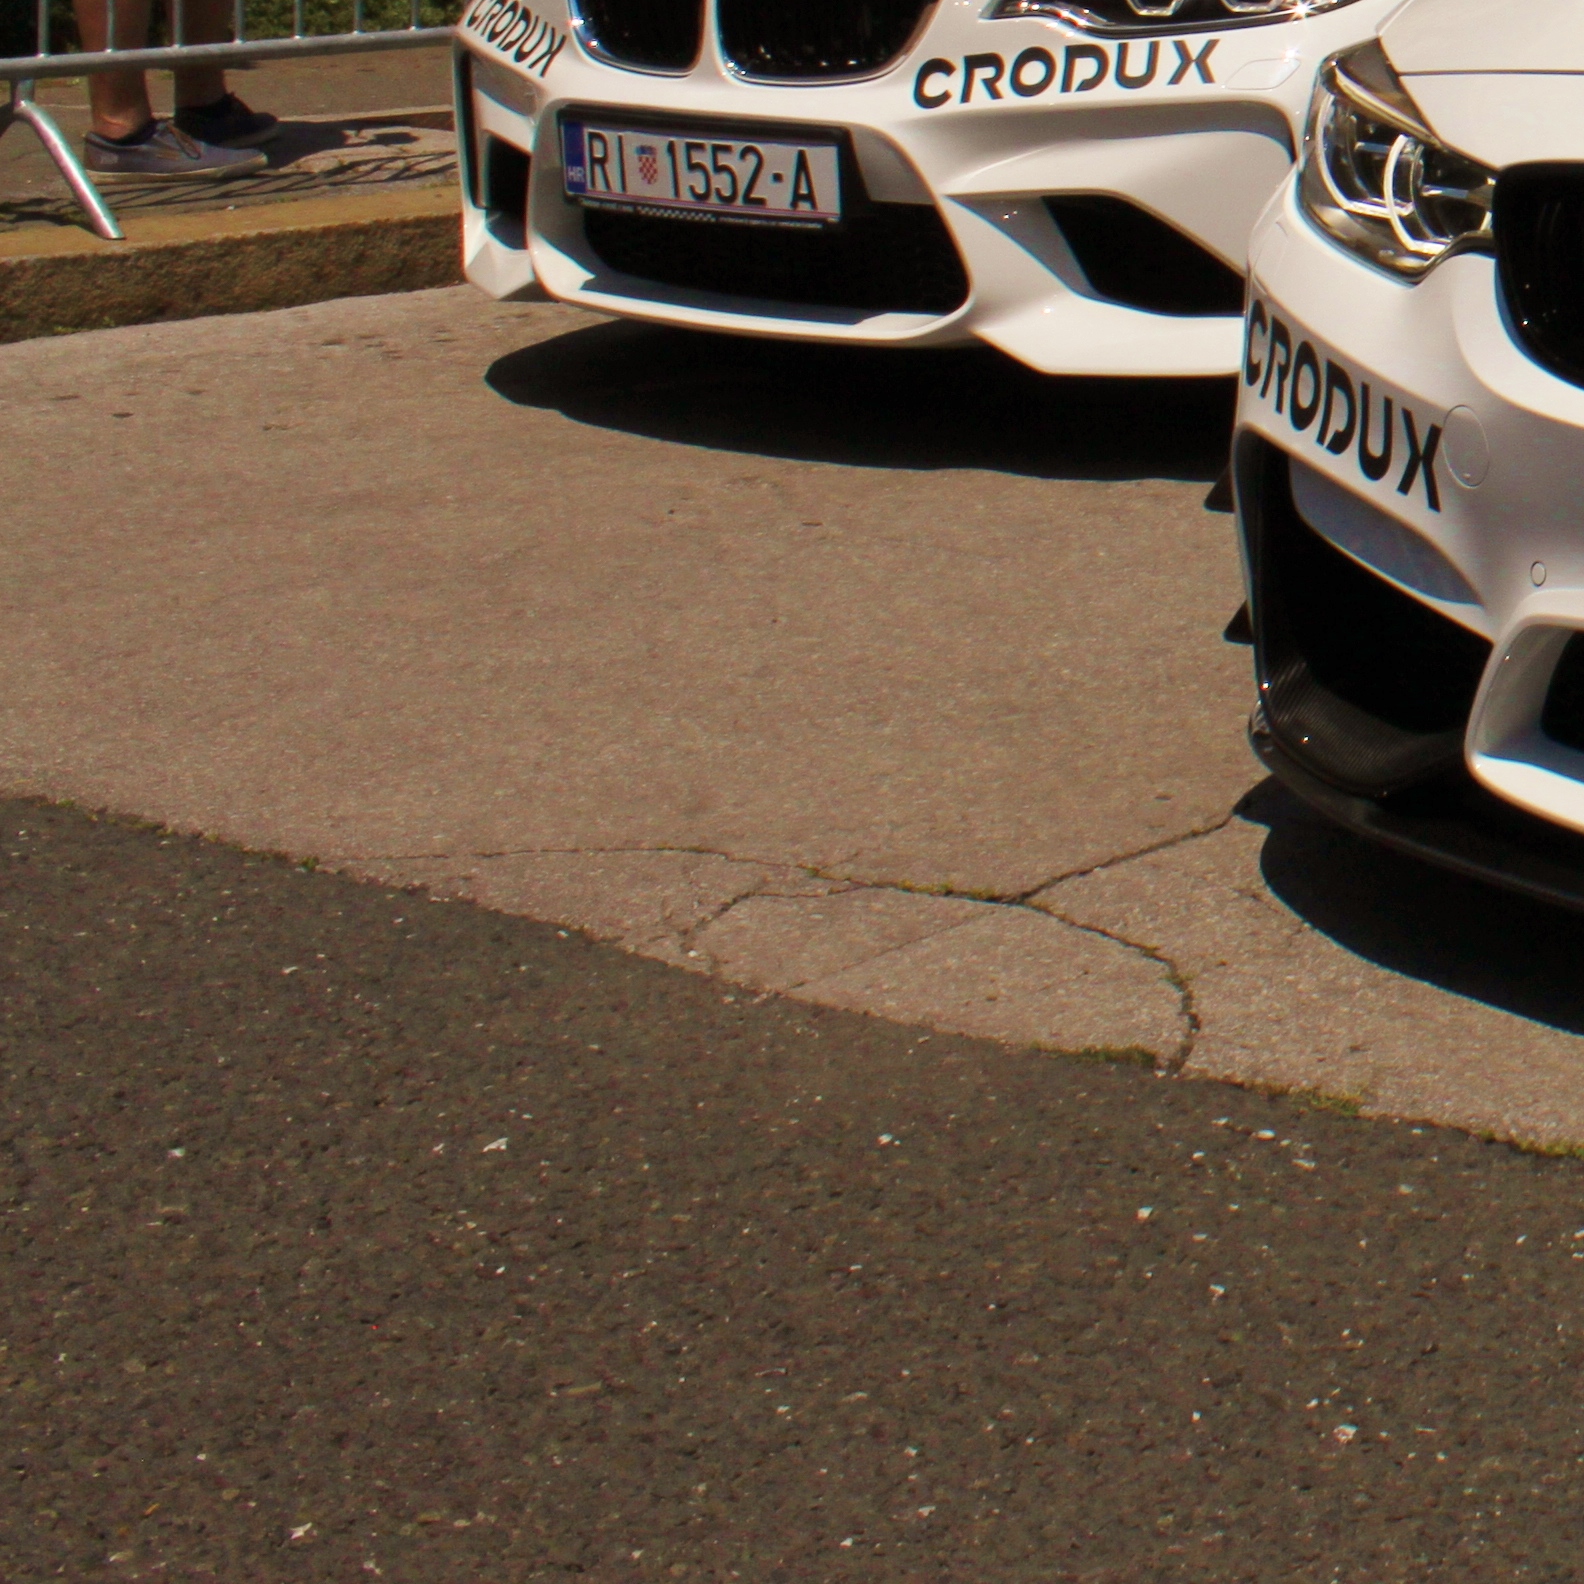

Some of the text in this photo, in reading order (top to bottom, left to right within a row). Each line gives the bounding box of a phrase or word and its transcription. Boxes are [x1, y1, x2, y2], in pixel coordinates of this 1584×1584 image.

[913, 39, 1221, 109] CRODUX
[567, 165, 586, 184] HR
[587, 130, 627, 194] RI
[1246, 299, 1442, 513] CRODUX
